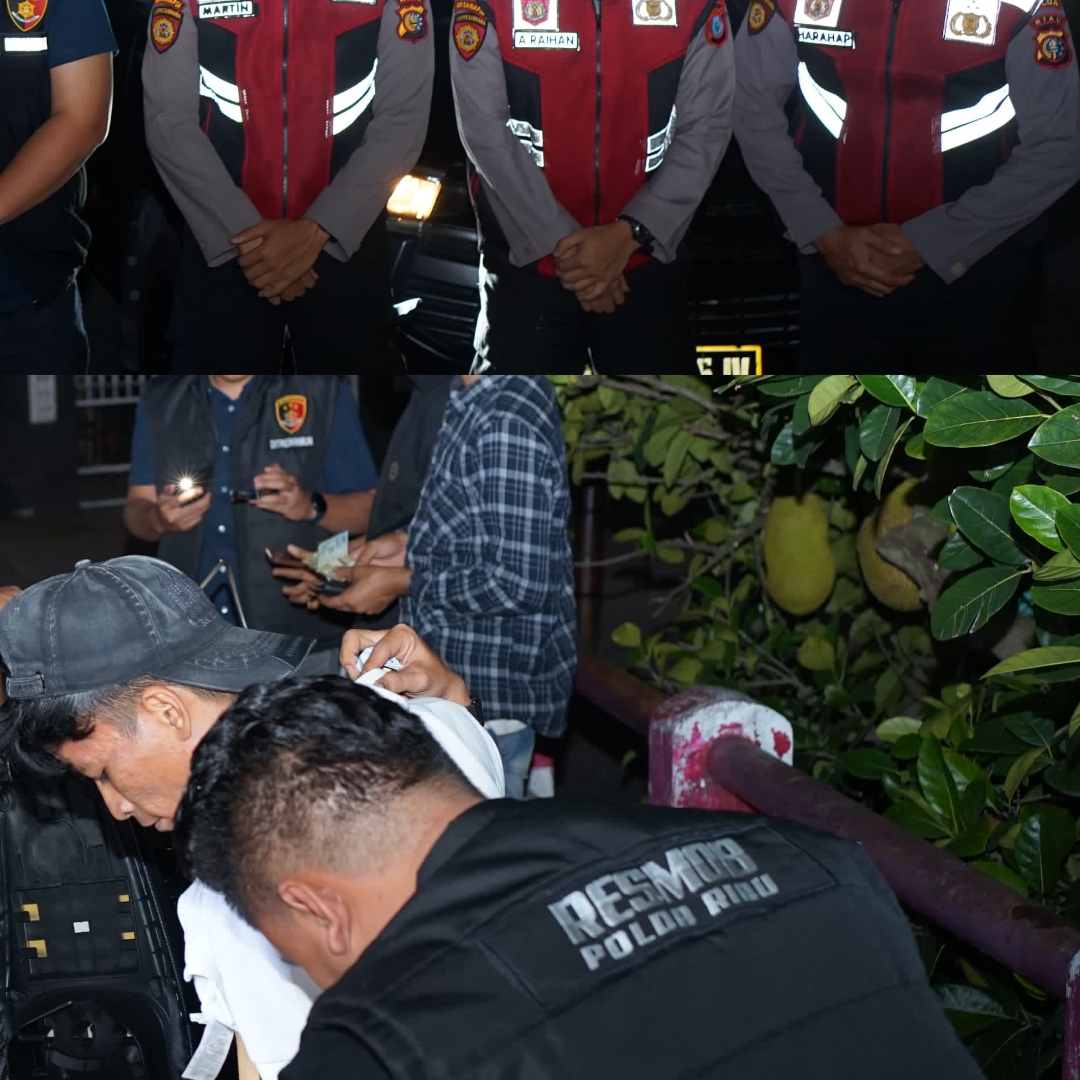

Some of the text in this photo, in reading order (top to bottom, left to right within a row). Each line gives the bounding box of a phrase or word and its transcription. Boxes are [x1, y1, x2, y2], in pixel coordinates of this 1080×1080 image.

[202, 3, 249, 16] MARTIN
[519, 35, 574, 45] A RAIHAN
[799, 31, 851, 43] HARAHAP
[547, 837, 758, 946] RESMOB
[580, 873, 780, 971] POLDA RIAU
